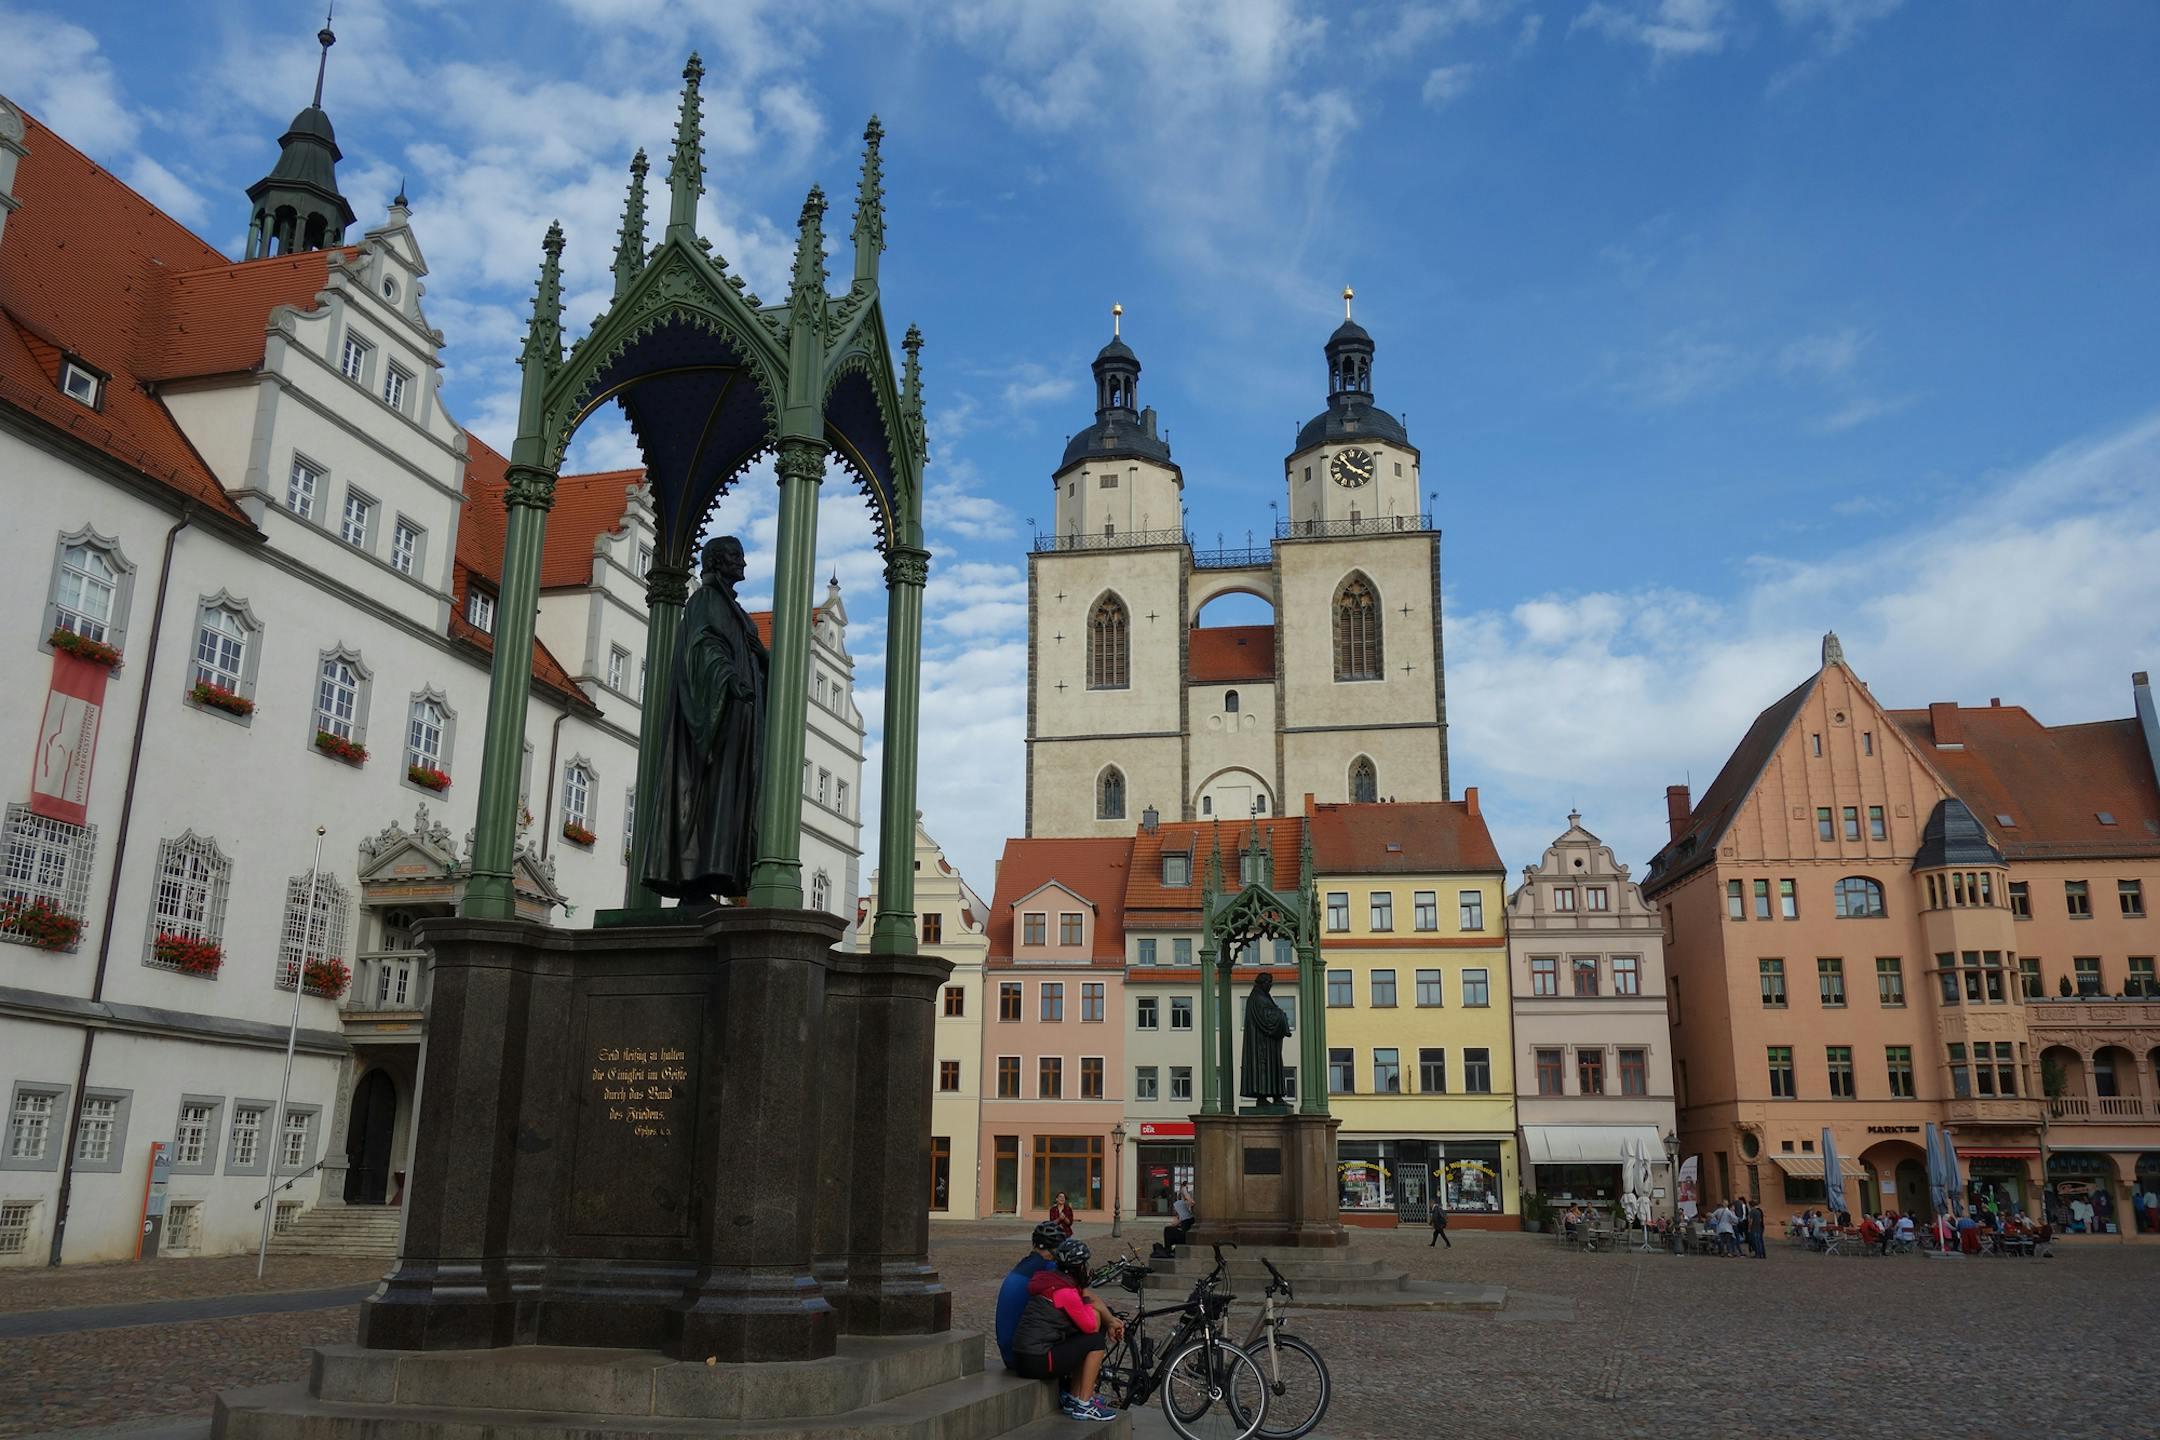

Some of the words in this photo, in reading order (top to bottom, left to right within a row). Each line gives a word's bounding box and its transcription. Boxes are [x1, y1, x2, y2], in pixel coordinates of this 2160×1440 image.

[76, 706, 95, 801] WITTENBERGSTIFTUNG
[660, 1048, 685, 1062] halten
[592, 1068, 605, 1080] die
[647, 1069, 658, 1080] im
[604, 1087, 626, 1103] durch
[628, 1087, 644, 1100] das
[647, 1085, 673, 1100] Band
[609, 1106, 623, 1120] des
